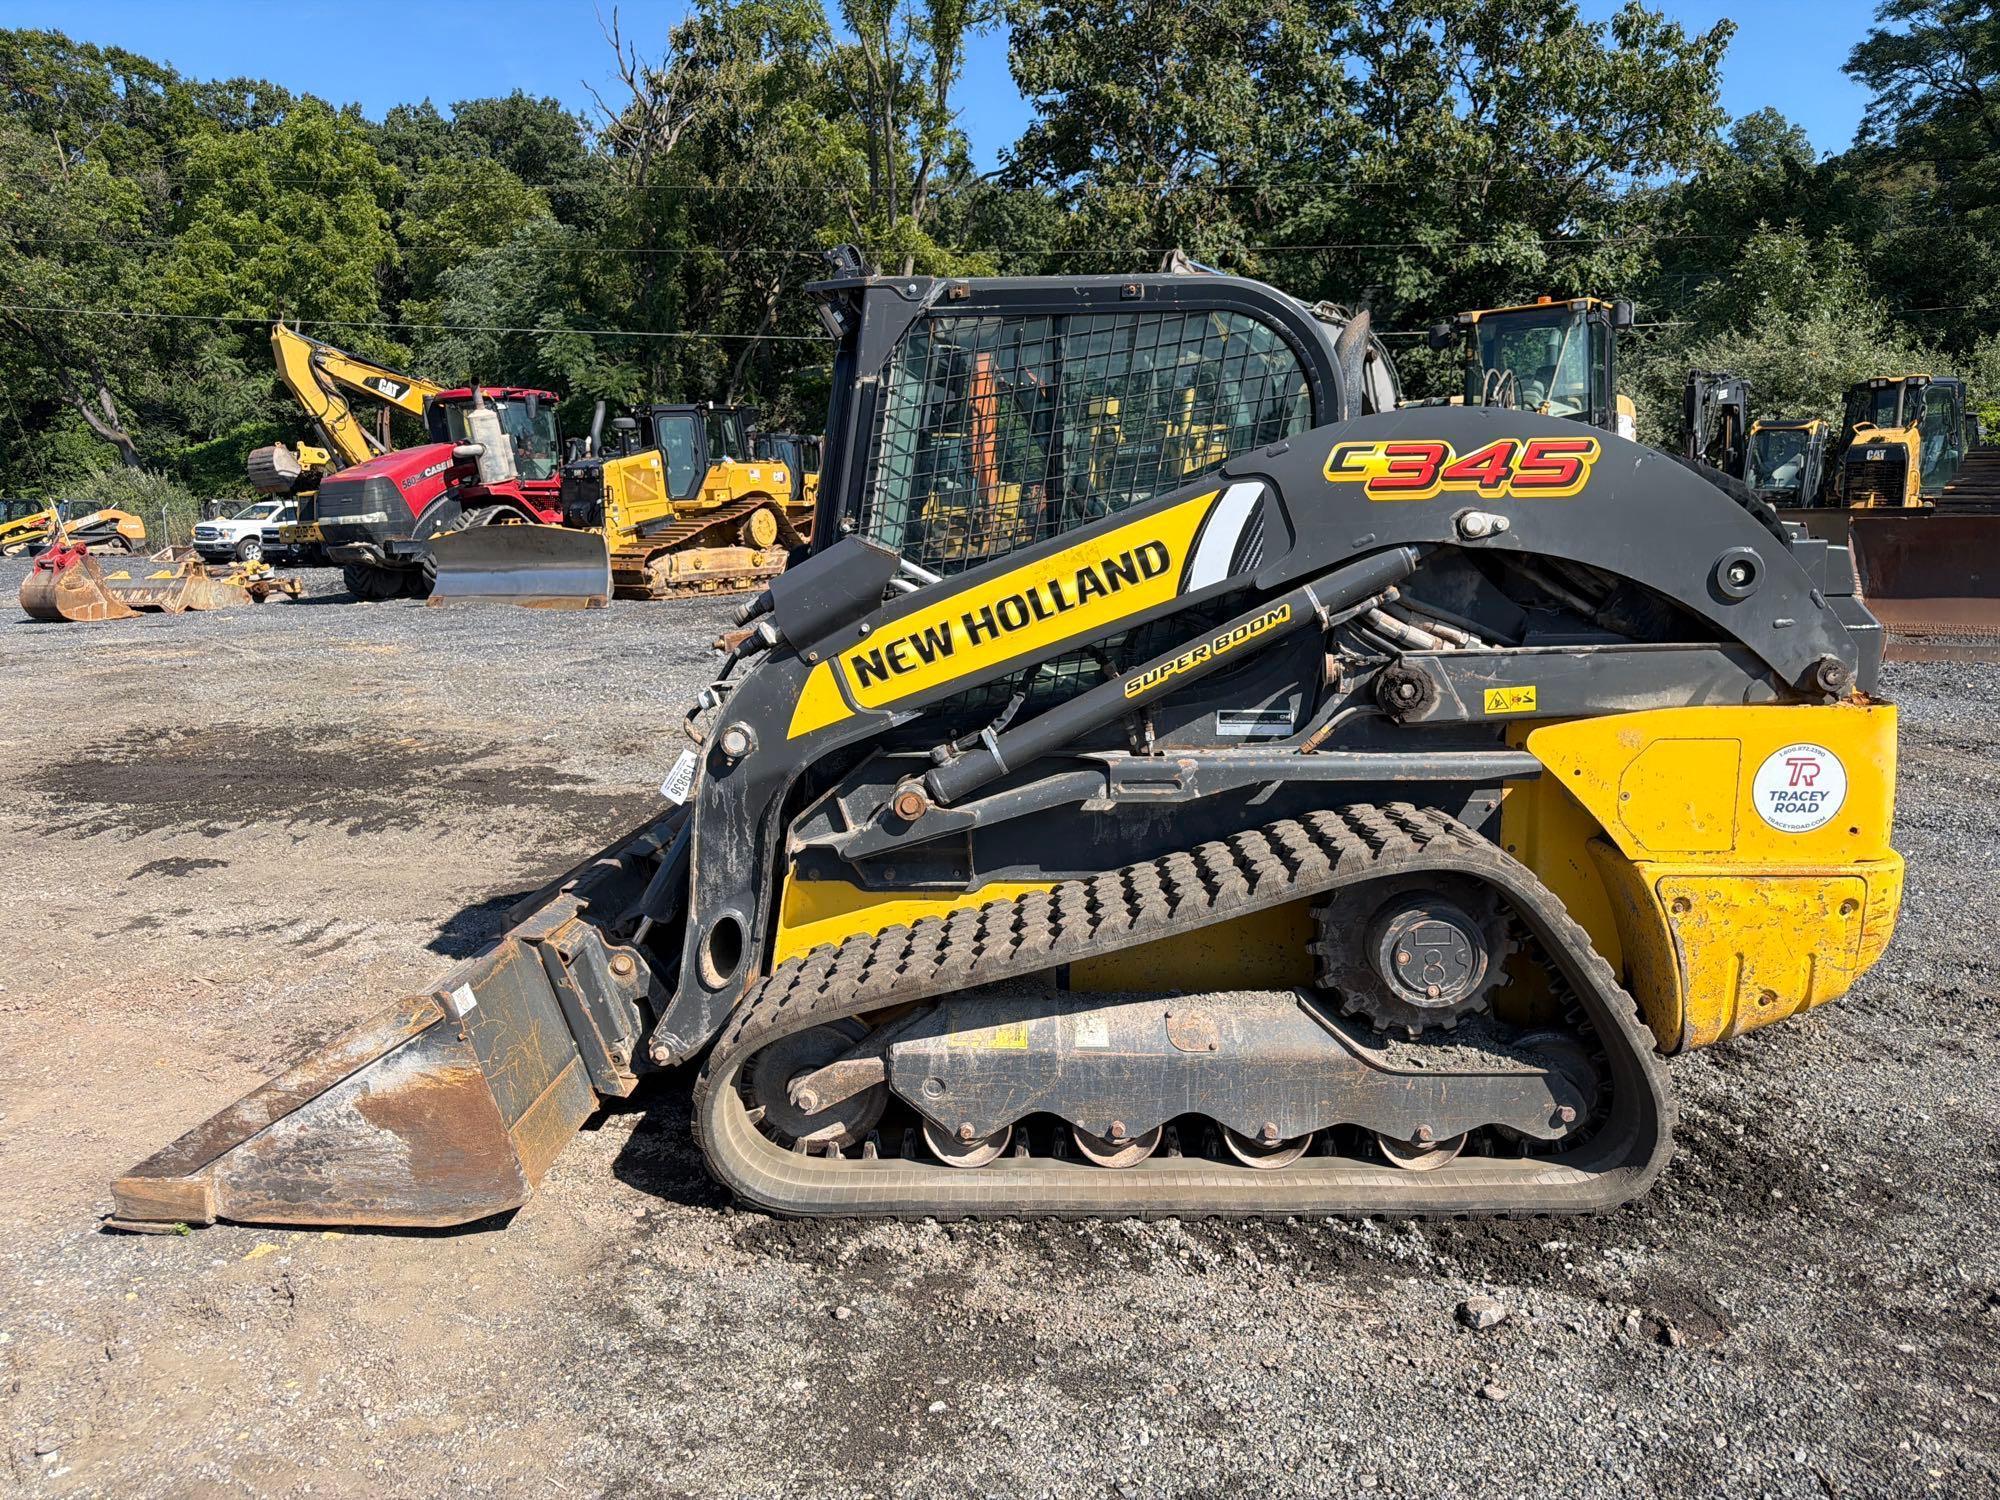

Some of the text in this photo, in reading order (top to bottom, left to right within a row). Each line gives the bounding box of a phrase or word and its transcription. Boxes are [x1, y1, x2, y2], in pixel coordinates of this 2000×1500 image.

[378, 378, 401, 398] CAT
[1866, 449, 1887, 461] CAT
[424, 462, 447, 477] CASE
[1324, 440, 1599, 497] C345
[851, 539, 1171, 689] NEW HOLLAND
[1126, 604, 1290, 697] SUPER BOOM
[1779, 746, 1826, 758] 1.800.872.2390
[1785, 757, 1821, 787] TR
[1769, 790, 1830, 802] TRACEY
[1773, 802, 1820, 813] ROAD
[1767, 816, 1827, 830] TRACEYROAD.COM
